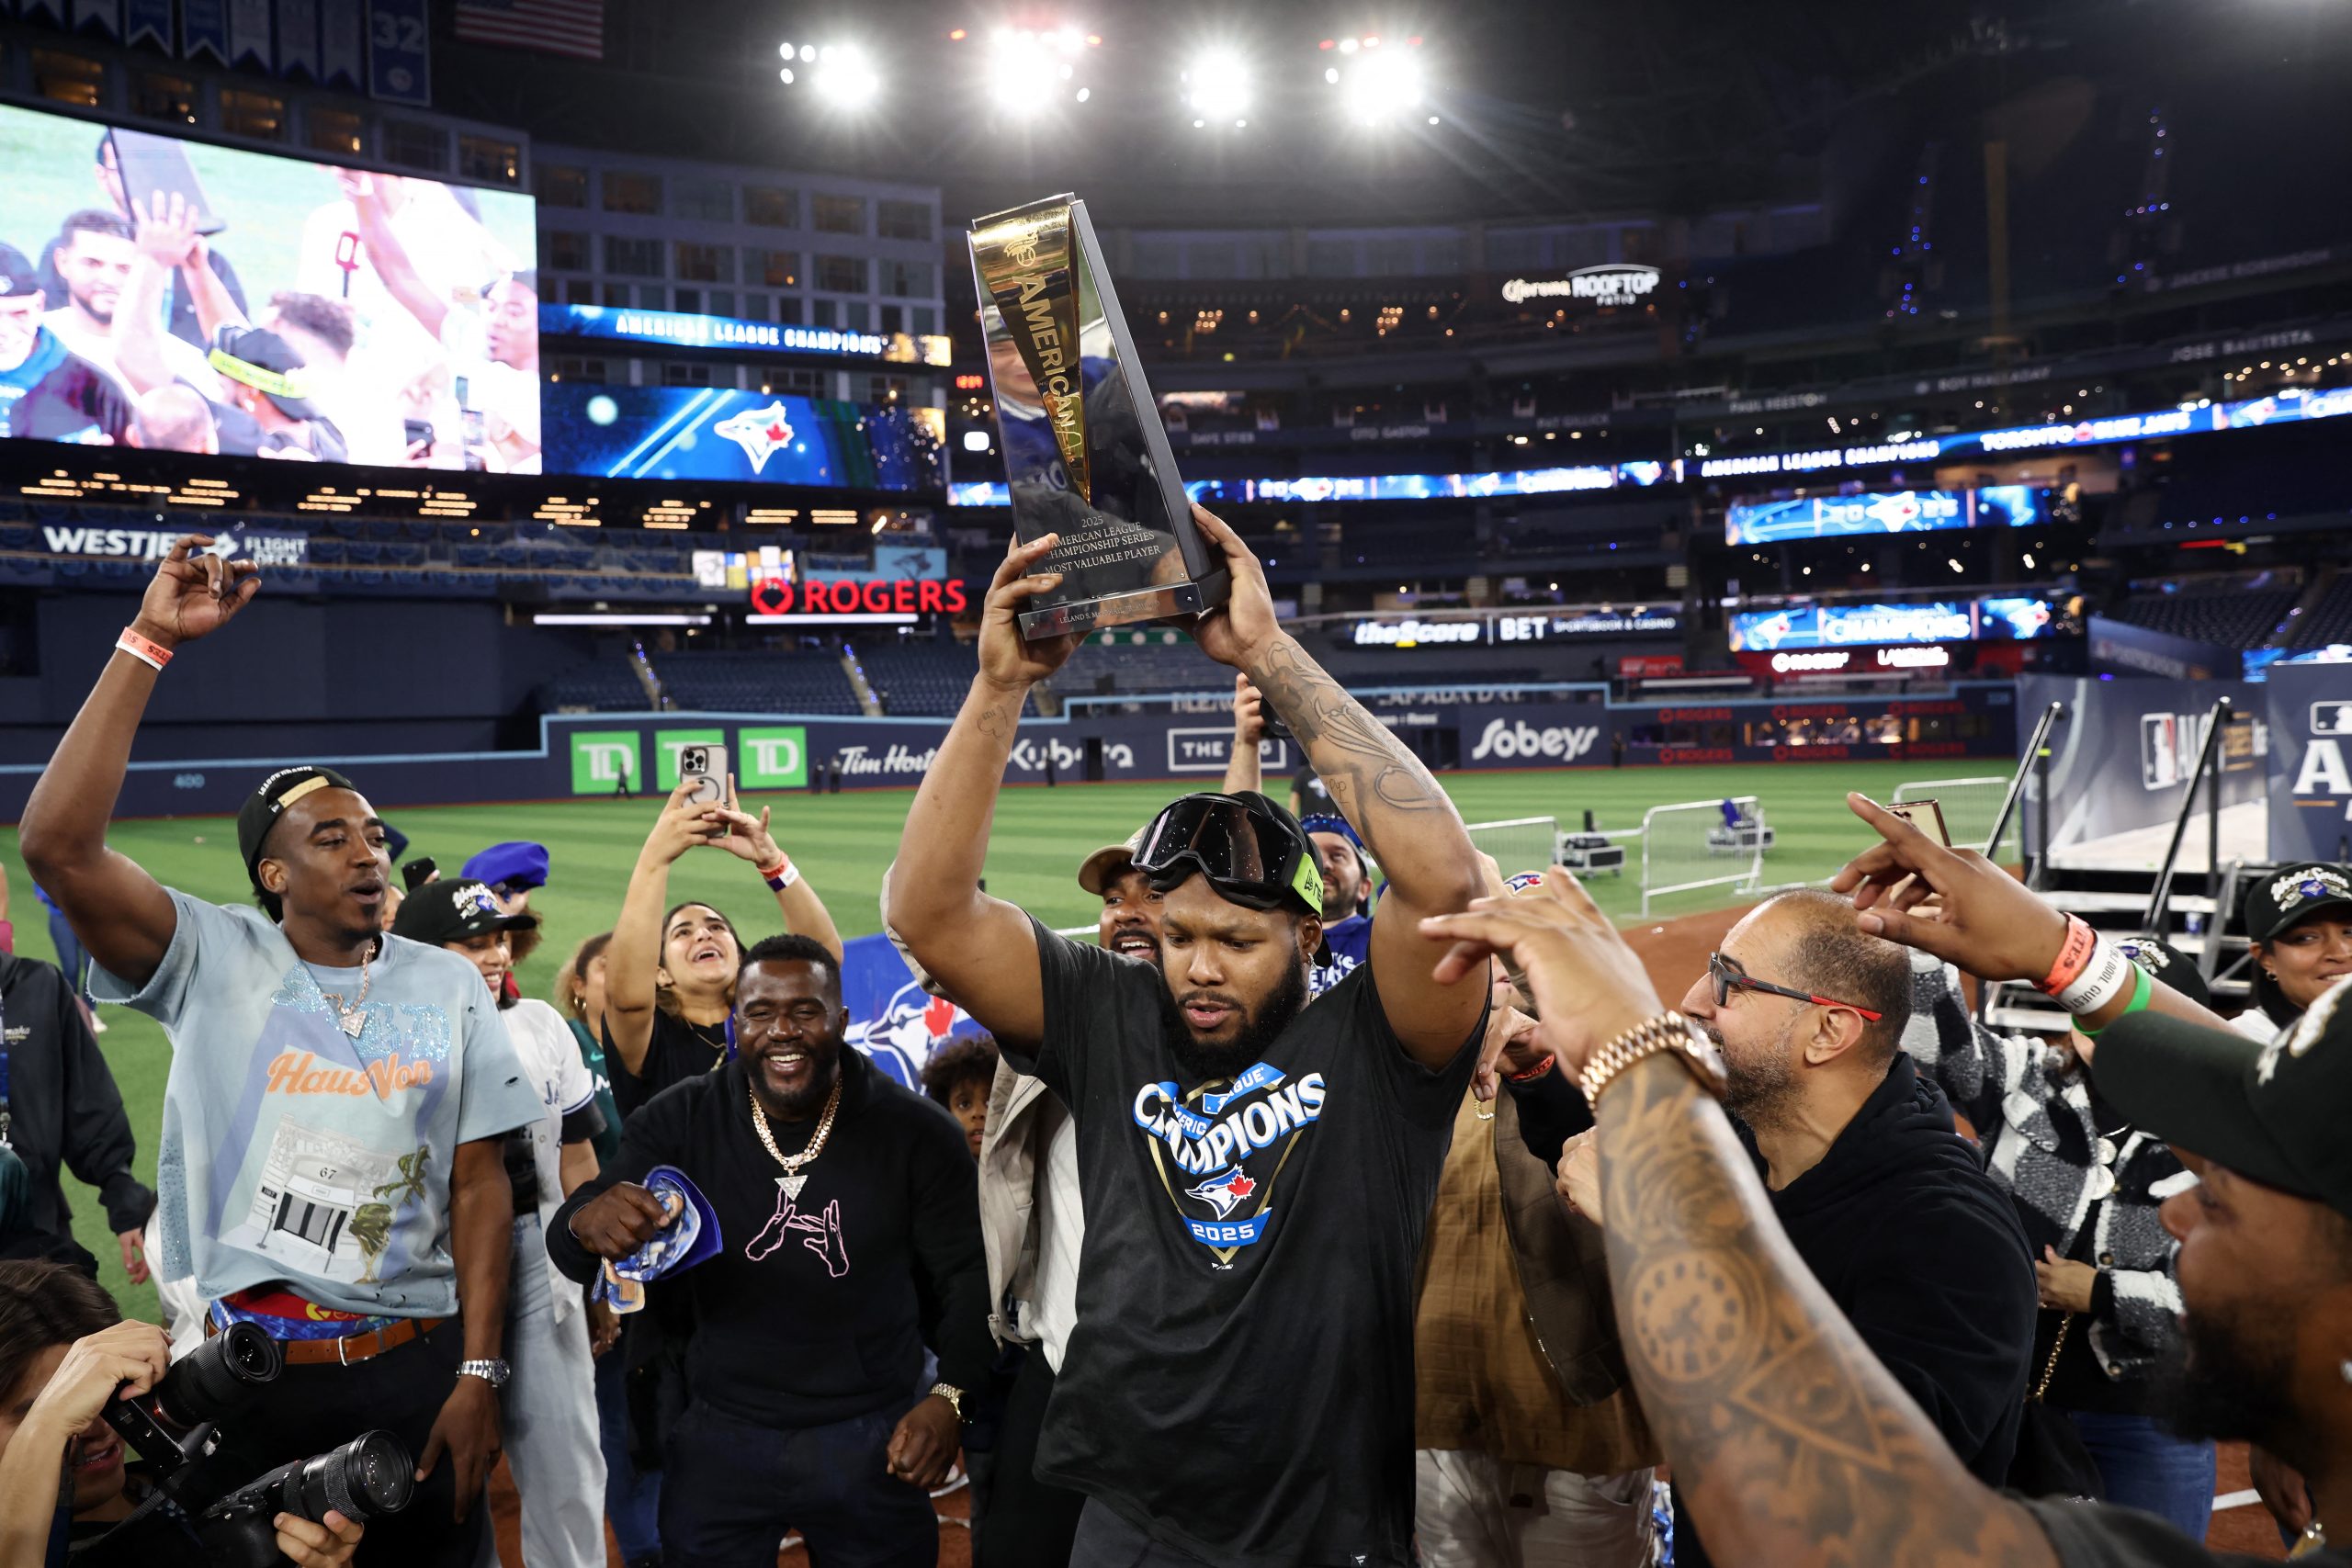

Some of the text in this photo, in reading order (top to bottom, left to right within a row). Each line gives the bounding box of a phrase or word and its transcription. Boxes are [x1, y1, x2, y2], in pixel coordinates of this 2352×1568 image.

[373, 13, 425, 51] 32
[1571, 272, 1659, 299] ROOFTOP
[616, 314, 882, 355] AMERICAN LEAGUE CHAMPIONS
[1012, 275, 1075, 428] AMERICAN
[1980, 424, 2074, 451] TORONTO
[1050, 521, 1142, 548] AMERICAN LEAGUE
[1080, 515, 1103, 528] 2025
[43, 525, 194, 560] WESTJE
[243, 536, 308, 553] FLIGHT
[1044, 530, 1155, 559] CHAMPIONSHIP SERIES
[1045, 544, 1161, 574] MOST VALUABLE PLAYER
[804, 579, 967, 614] ROGERS
[1059, 613, 1086, 624] LELAND
[1354, 620, 1480, 644] theScore
[1499, 616, 1548, 640] BET
[1825, 614, 1972, 642] CHAMPIONS
[1182, 741, 1224, 758] THE
[1472, 717, 1600, 761] Sobeys
[579, 742, 634, 781] TD
[745, 738, 799, 775] TD
[839, 744, 938, 774] Tim Hort
[1007, 739, 1136, 771] Kuba
[2071, 984, 2102, 1010] GUEST
[1229, 1066, 1265, 1095] GUE
[320, 1167, 337, 1179] 67
[1191, 1223, 1256, 1241] 2025
